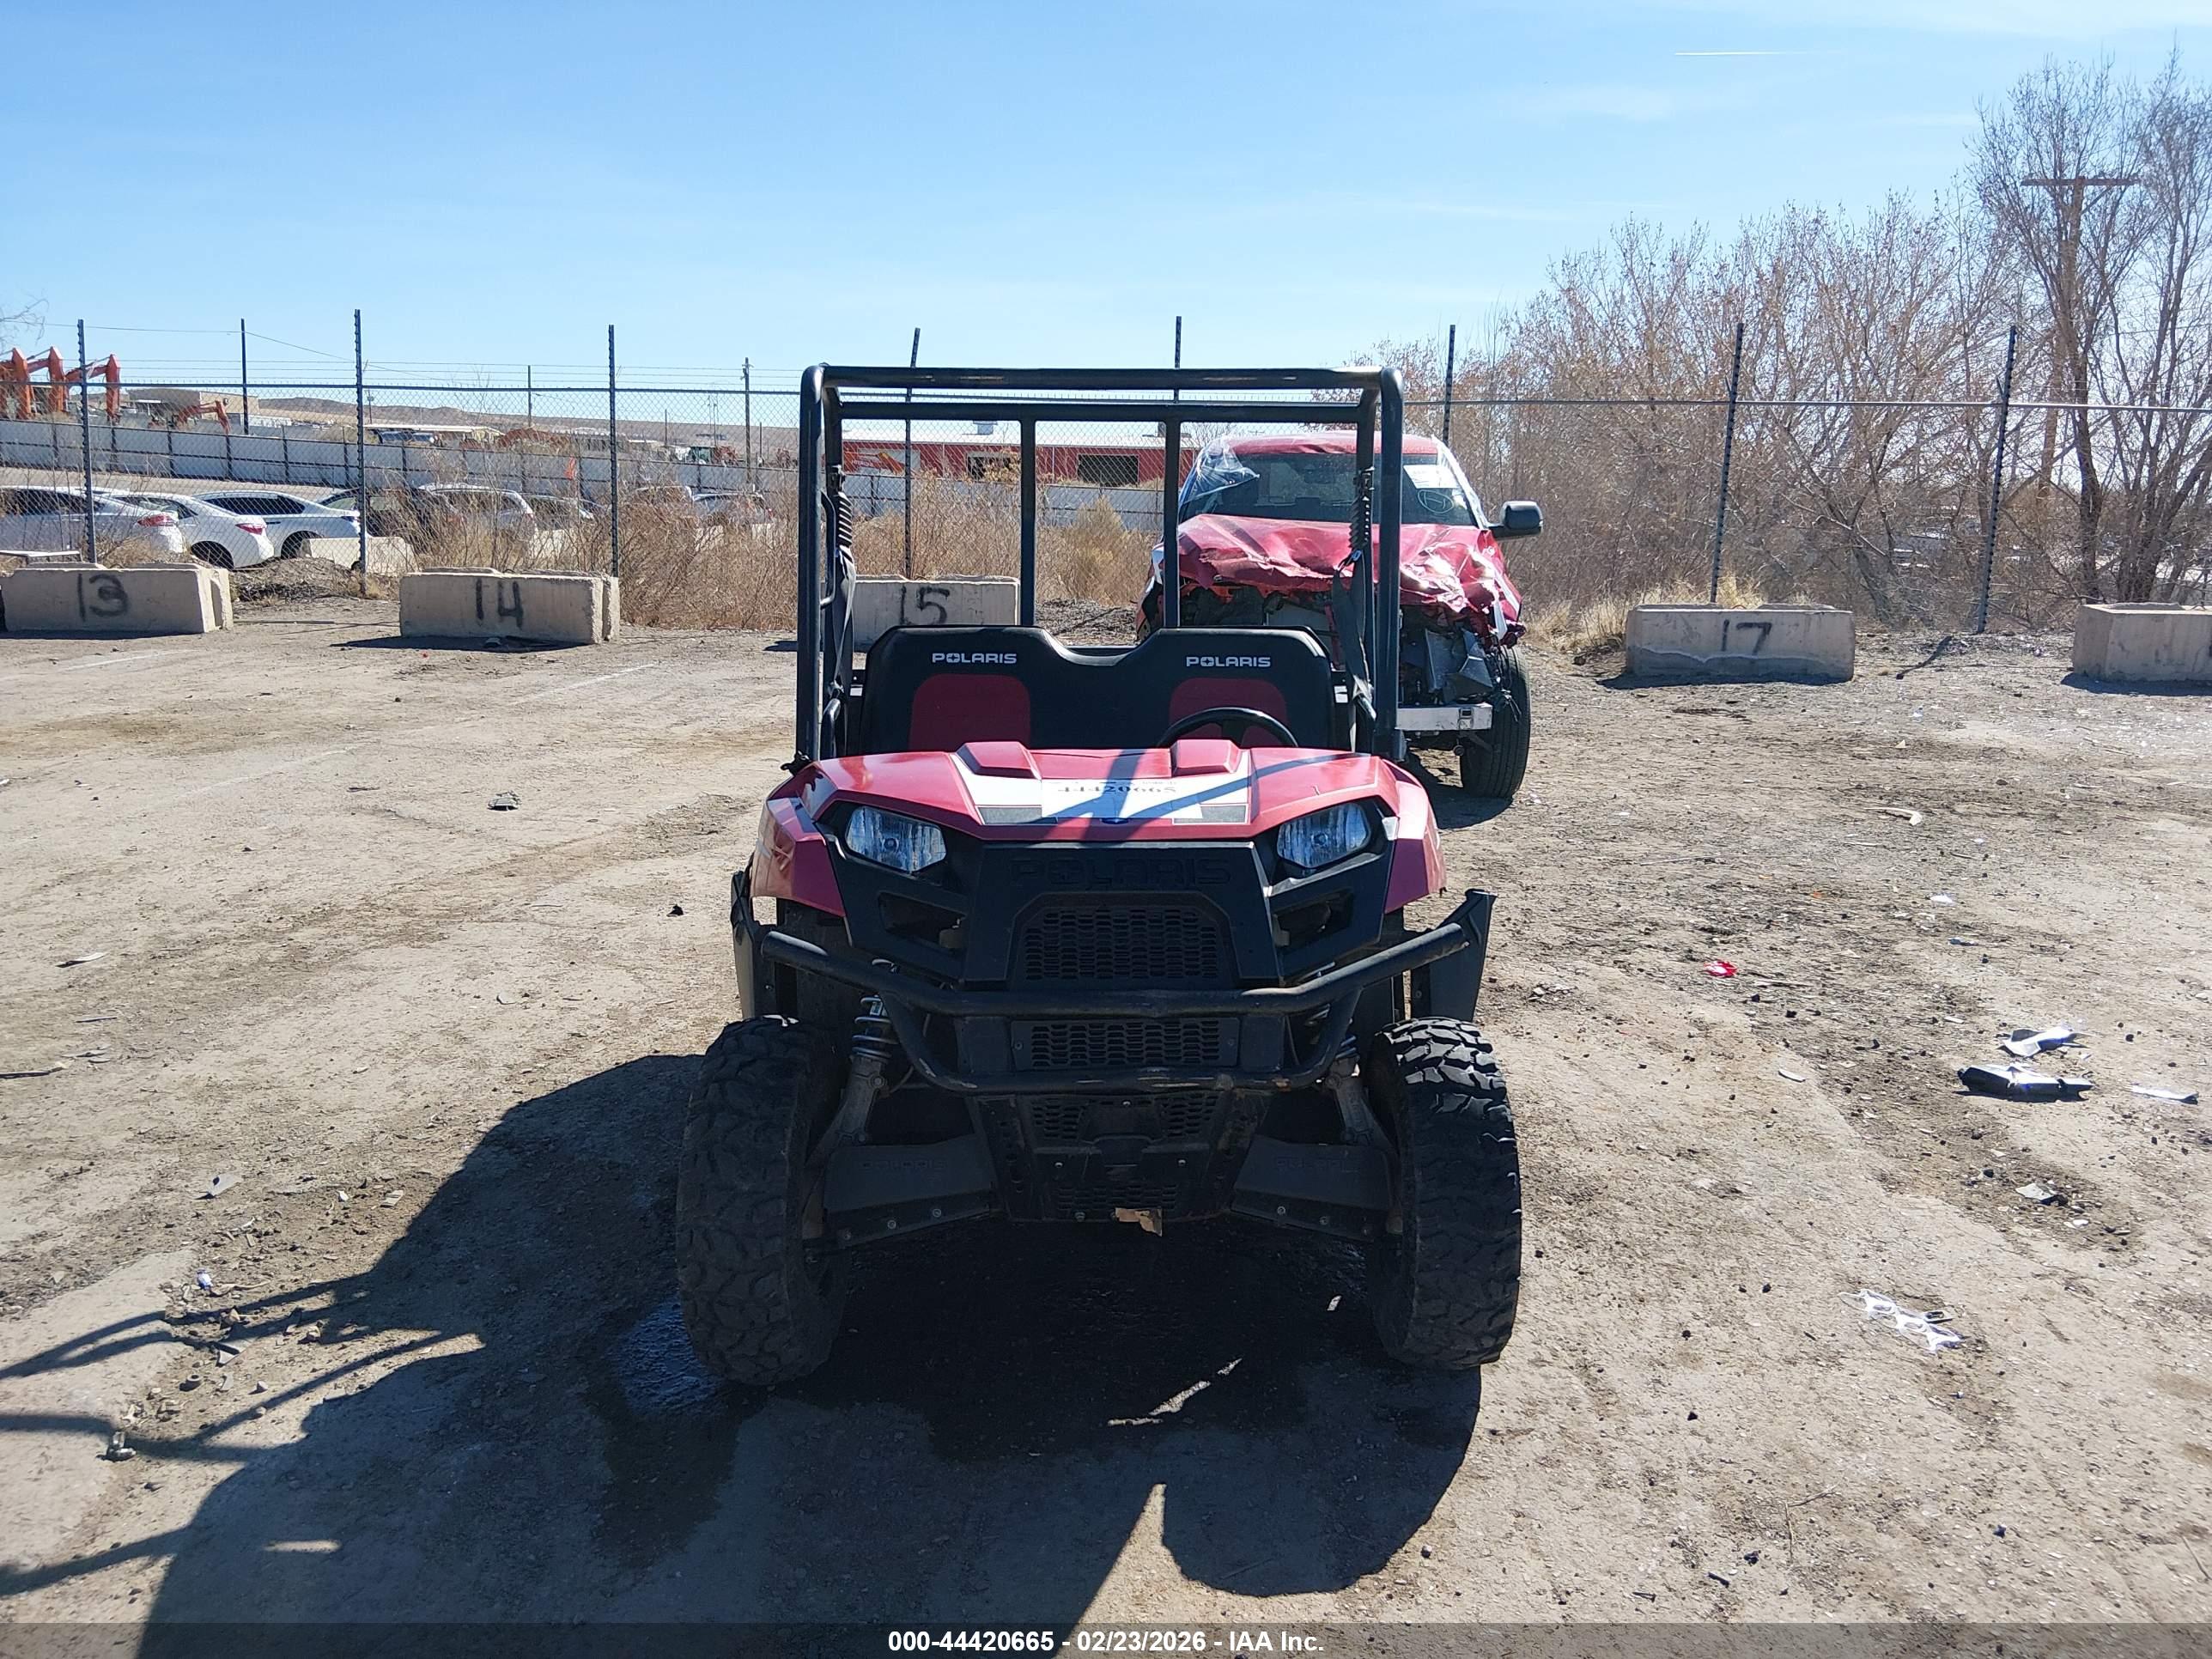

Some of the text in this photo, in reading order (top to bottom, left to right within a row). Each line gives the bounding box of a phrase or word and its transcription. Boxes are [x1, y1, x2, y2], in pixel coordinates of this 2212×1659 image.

[77, 573, 129, 622] 13
[475, 577, 524, 629] 14
[899, 586, 950, 625] 15
[1721, 619, 1772, 655] 17
[932, 653, 1017, 664] POLARIS
[1186, 656, 1271, 667] POLARIS
[1009, 858, 1231, 885] POLARIS
